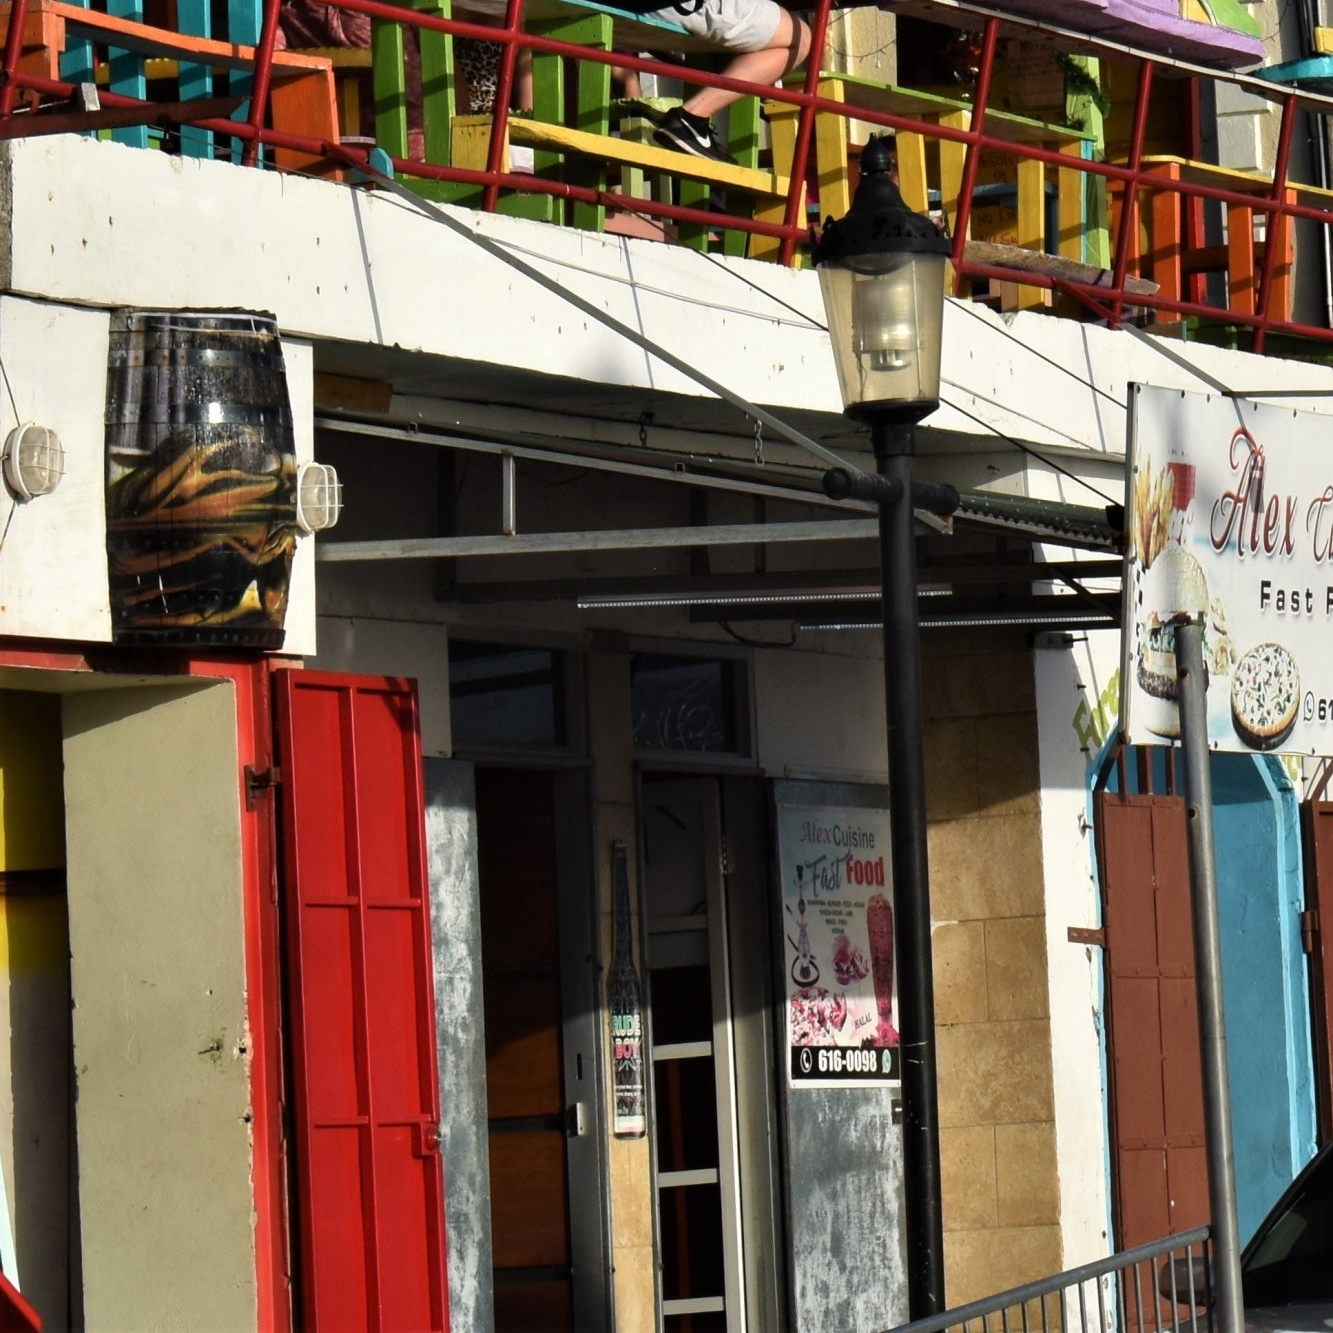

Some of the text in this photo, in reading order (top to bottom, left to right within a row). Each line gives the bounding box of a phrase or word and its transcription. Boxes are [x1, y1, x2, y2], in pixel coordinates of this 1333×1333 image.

[1210, 427, 1298, 559] Alex
[1260, 579, 1313, 616] Fast
[800, 819, 875, 849] Alex Cuisine
[805, 849, 850, 897] Fast
[612, 1014, 641, 1036] RUDE
[854, 1015, 873, 1031] HALAL
[615, 1037, 640, 1059] BOY
[818, 1049, 878, 1073] 616-0098
